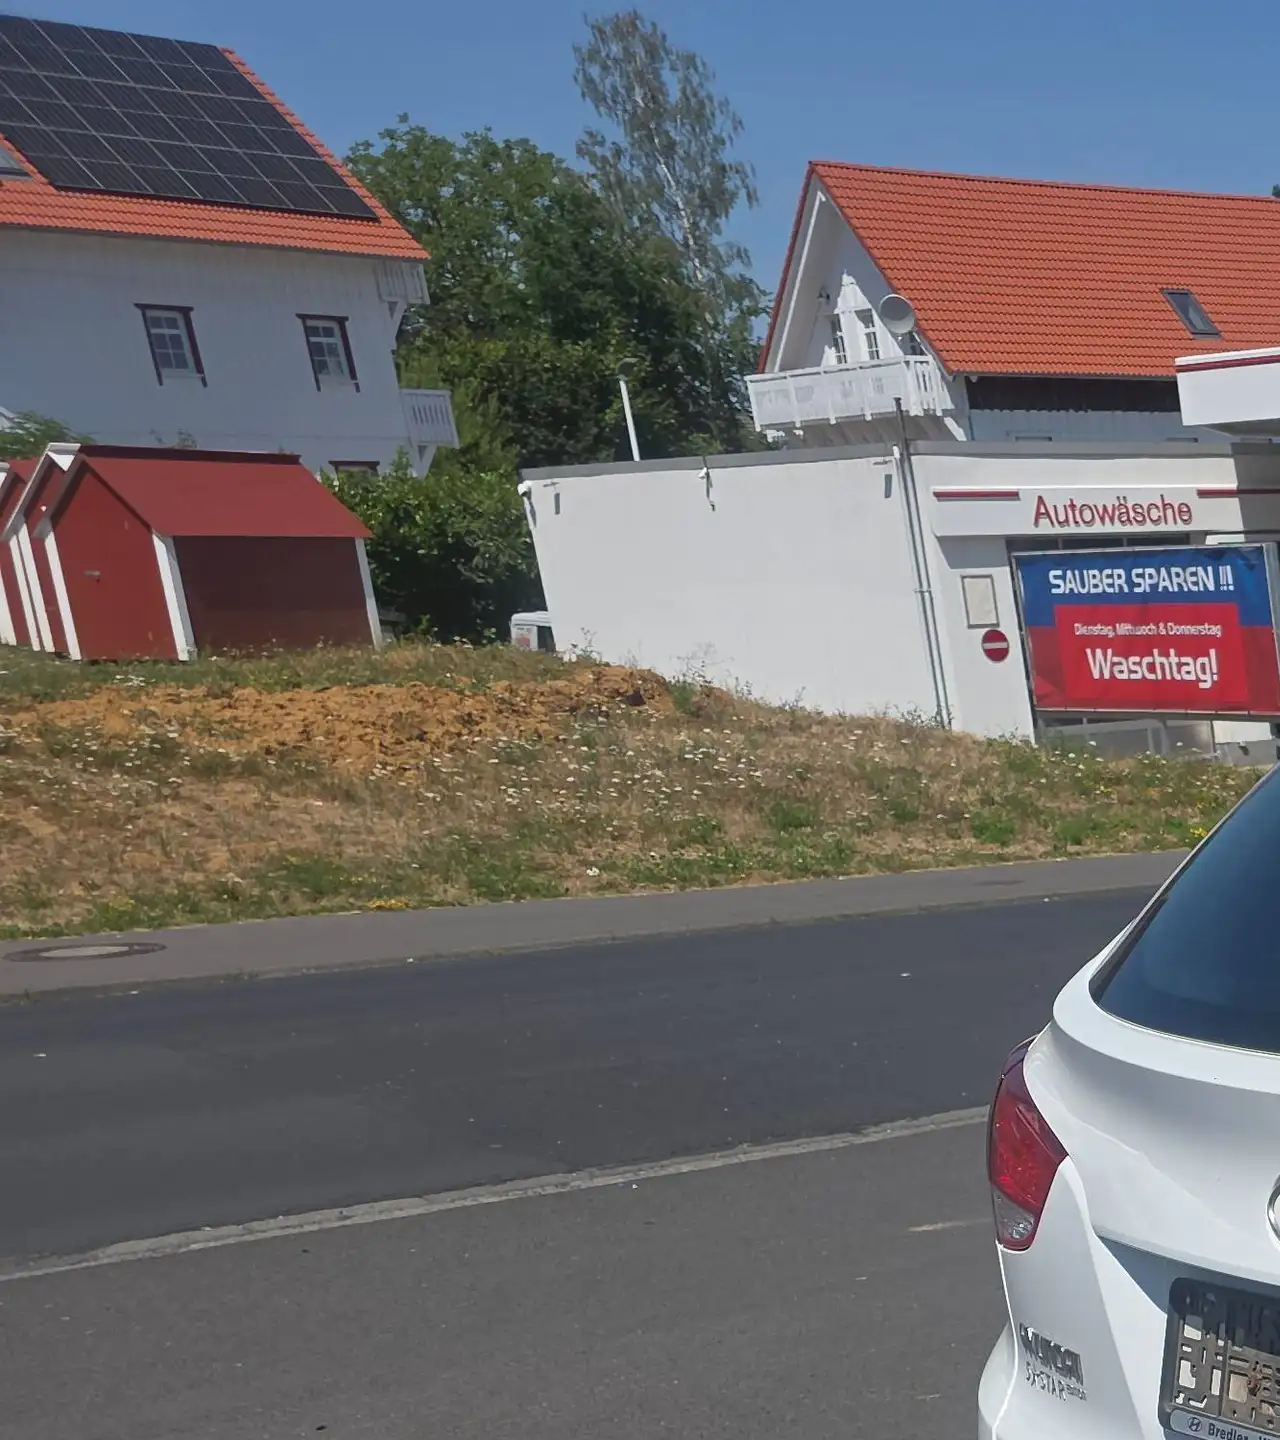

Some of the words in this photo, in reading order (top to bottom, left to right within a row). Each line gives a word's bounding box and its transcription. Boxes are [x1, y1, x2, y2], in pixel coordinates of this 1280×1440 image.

[1033, 495, 1193, 527] Autowäsche
[1049, 569, 1129, 594] SAUBER
[1132, 565, 1214, 594] SPAREN
[1219, 564, 1234, 591] !!!
[1074, 623, 1115, 637] Dienstag,
[1158, 622, 1167, 635] &
[1167, 622, 1222, 637] Donnerstag
[1085, 648, 1218, 689] Waschtag!
